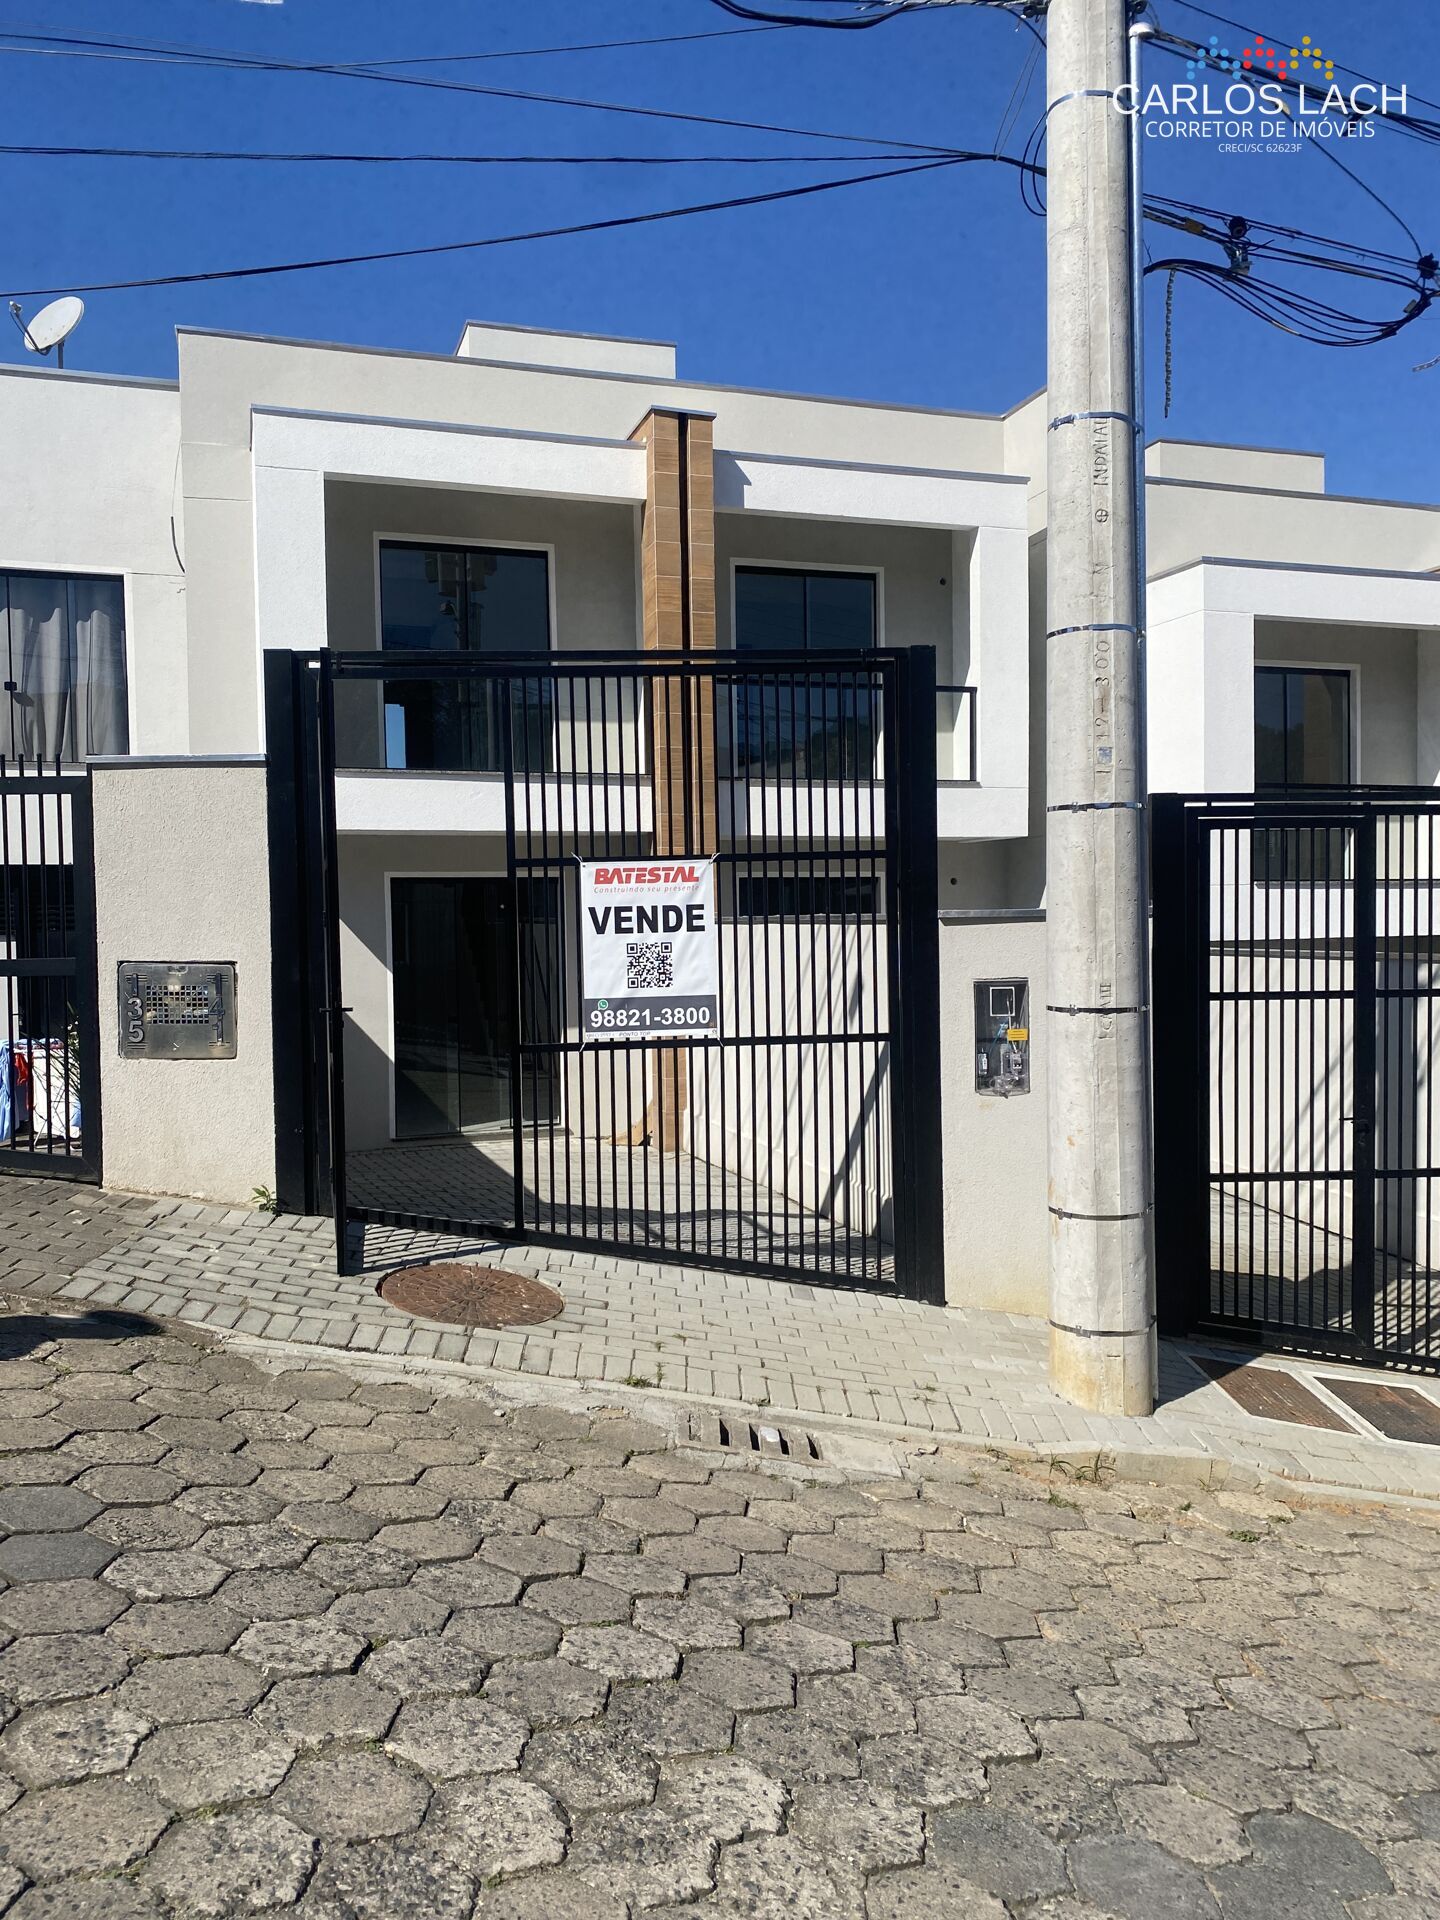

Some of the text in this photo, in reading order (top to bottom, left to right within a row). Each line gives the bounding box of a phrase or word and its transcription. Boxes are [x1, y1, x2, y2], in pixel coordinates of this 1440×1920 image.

[594, 866, 699, 885] BATESTAL
[593, 886, 644, 894] Construindo
[588, 904, 706, 935] VENDE
[590, 1007, 710, 1028] 98821-3800
